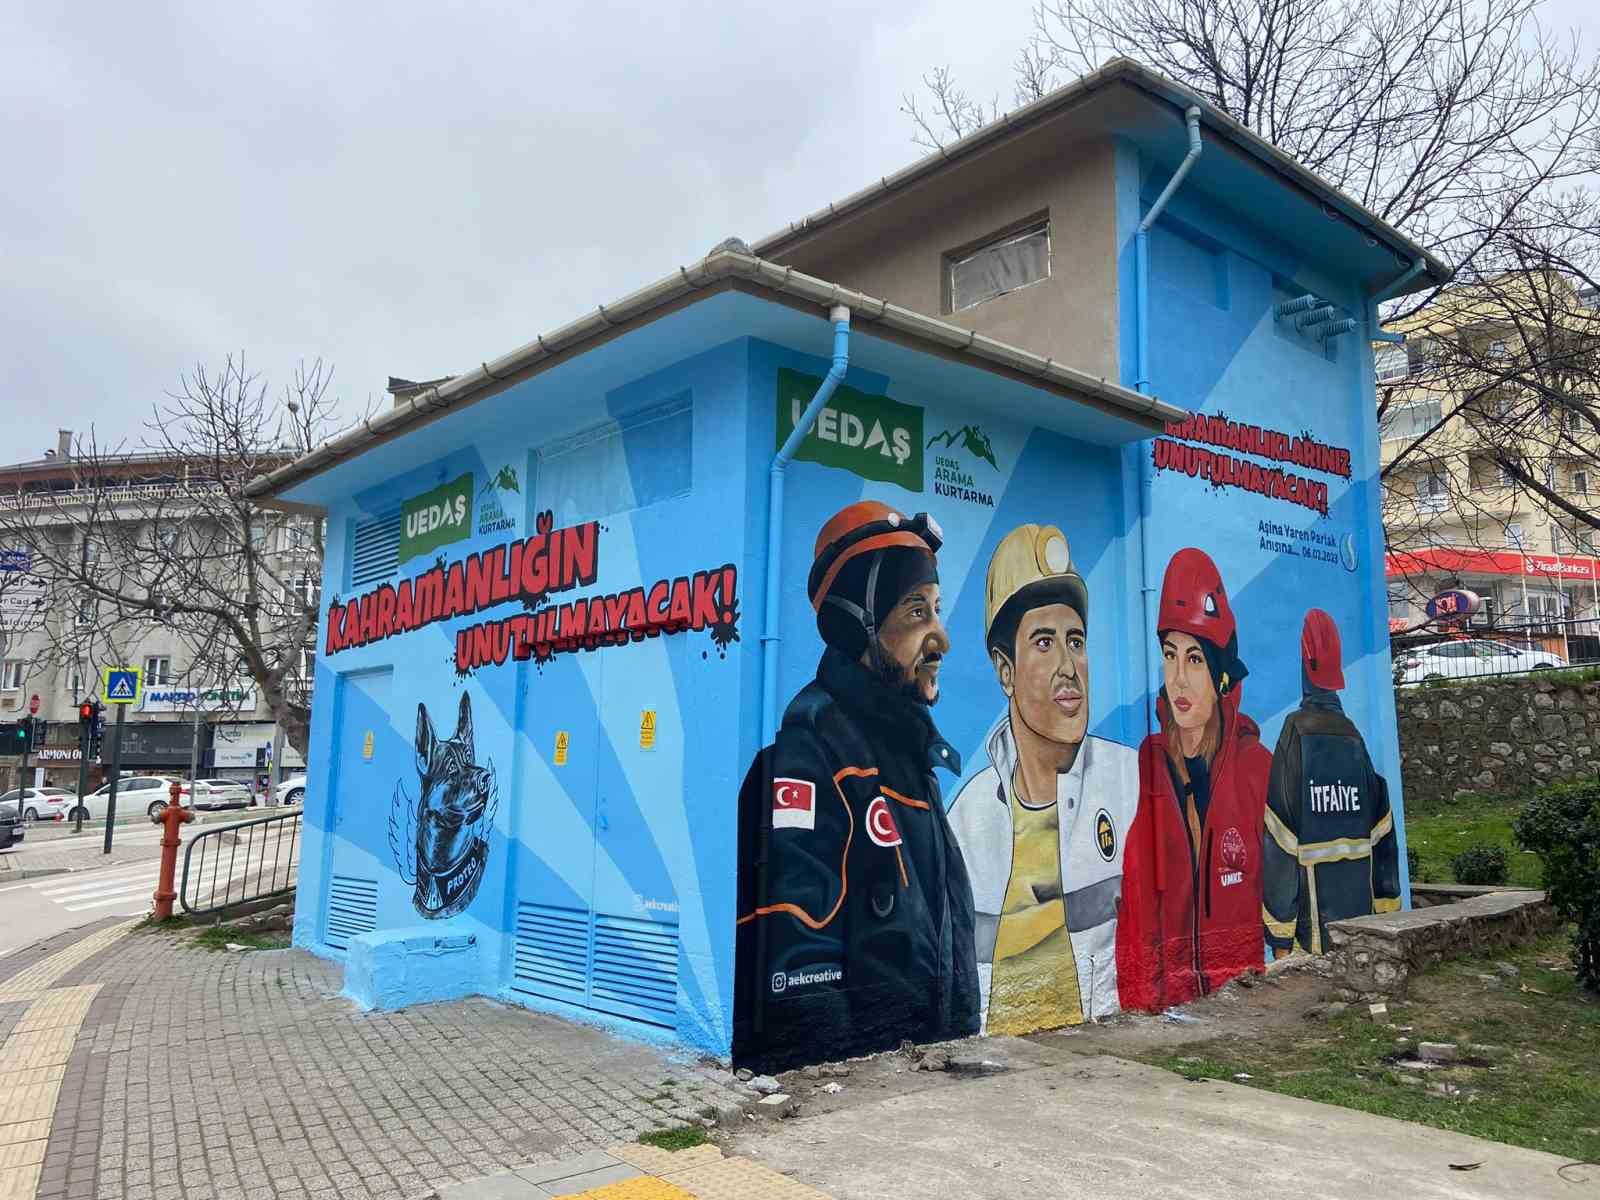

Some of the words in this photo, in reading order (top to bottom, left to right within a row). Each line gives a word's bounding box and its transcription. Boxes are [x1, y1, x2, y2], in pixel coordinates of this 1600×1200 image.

[935, 467, 974, 487] ARAMA
[1153, 438, 1329, 514] UNUTULMAYACAK!
[935, 482, 994, 507] KURTARMA
[406, 494, 466, 539] UEDAŞ
[479, 518, 516, 537] KURTARMA
[1258, 520, 1283, 537] Aşina
[1284, 524, 1310, 542] Yaren
[326, 510, 599, 656] KAHRAMANLIĞIN
[455, 564, 738, 672] UNUTULMAYACAK!
[1310, 780, 1361, 812] İTFAİYE
[1220, 871, 1244, 887] UMKE
[788, 969, 841, 985] aekcreative
